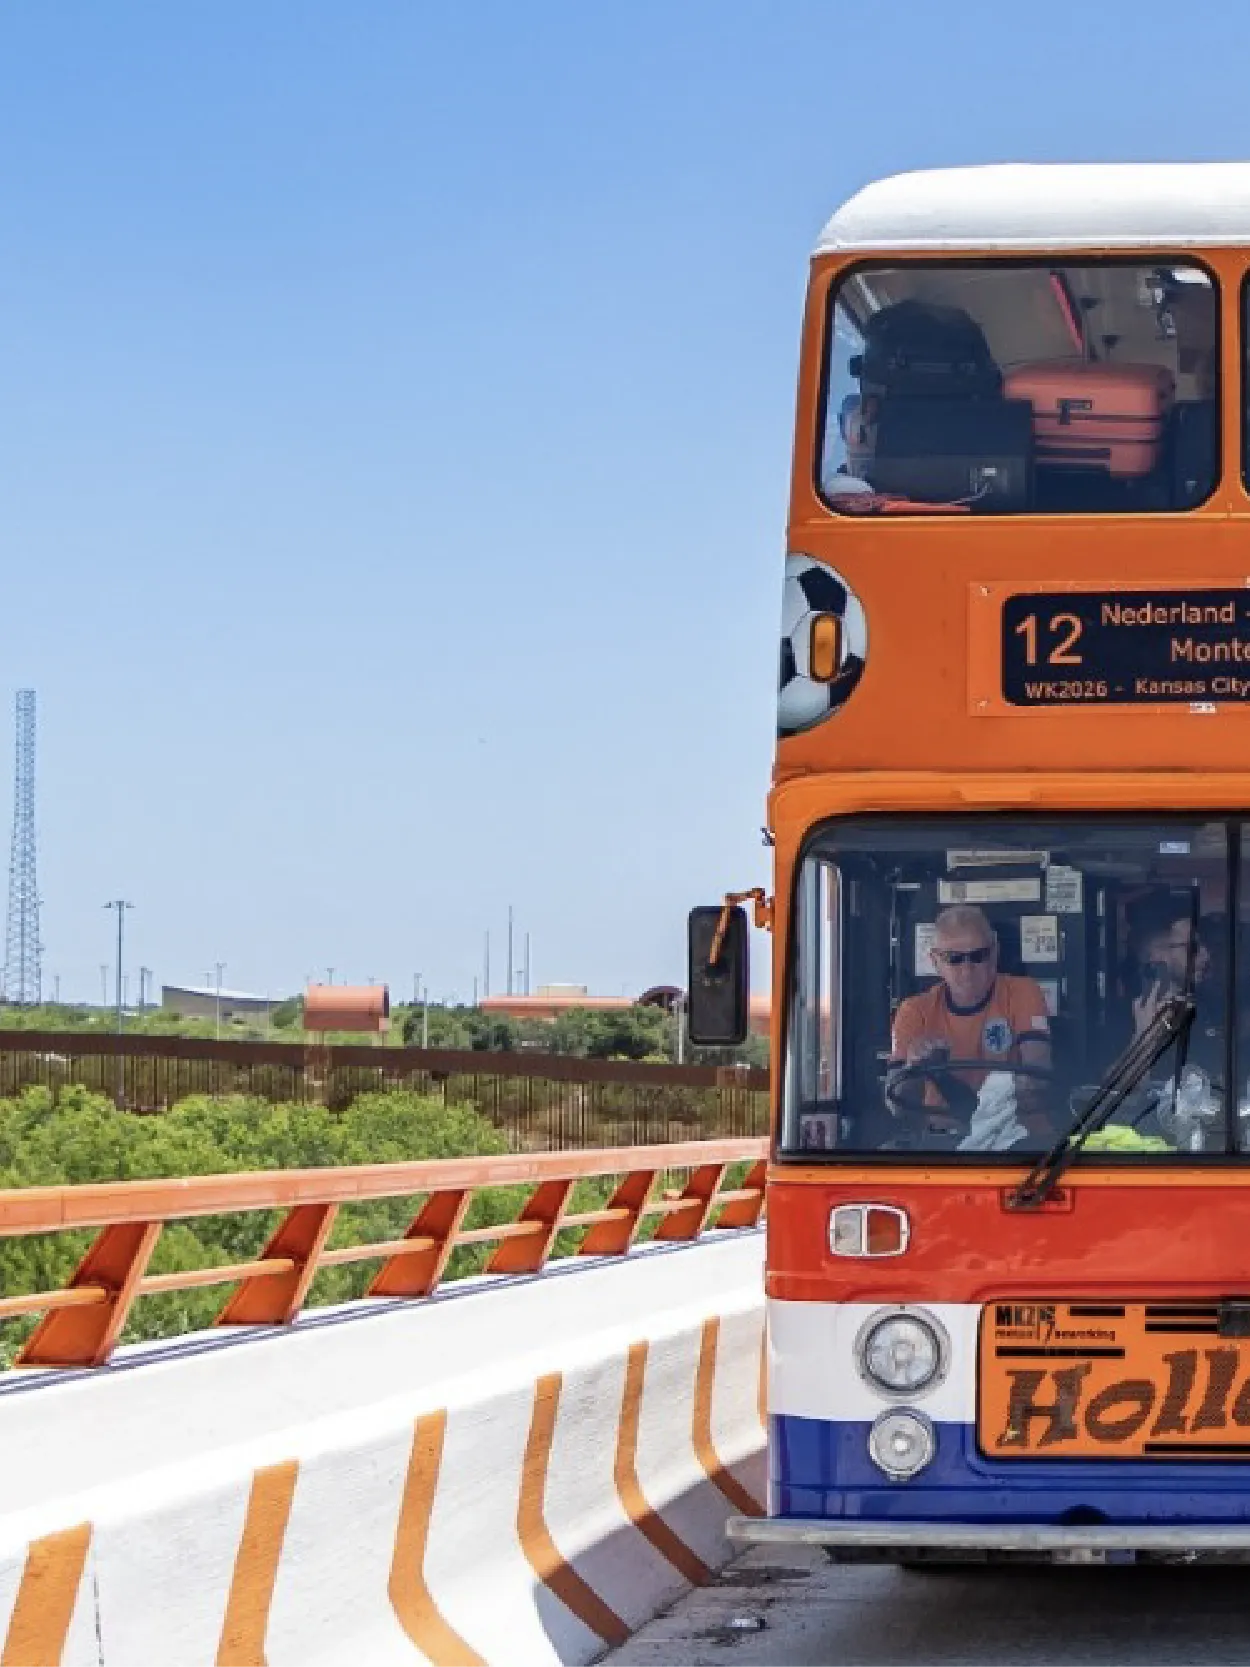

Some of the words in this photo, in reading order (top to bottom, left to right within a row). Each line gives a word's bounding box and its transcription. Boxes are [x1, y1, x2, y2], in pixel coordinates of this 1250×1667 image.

[1101, 601, 1236, 626] Nederland
[1014, 613, 1083, 666] 12
[1024, 680, 1108, 699] WK2026
[1135, 677, 1206, 694] Kansas
